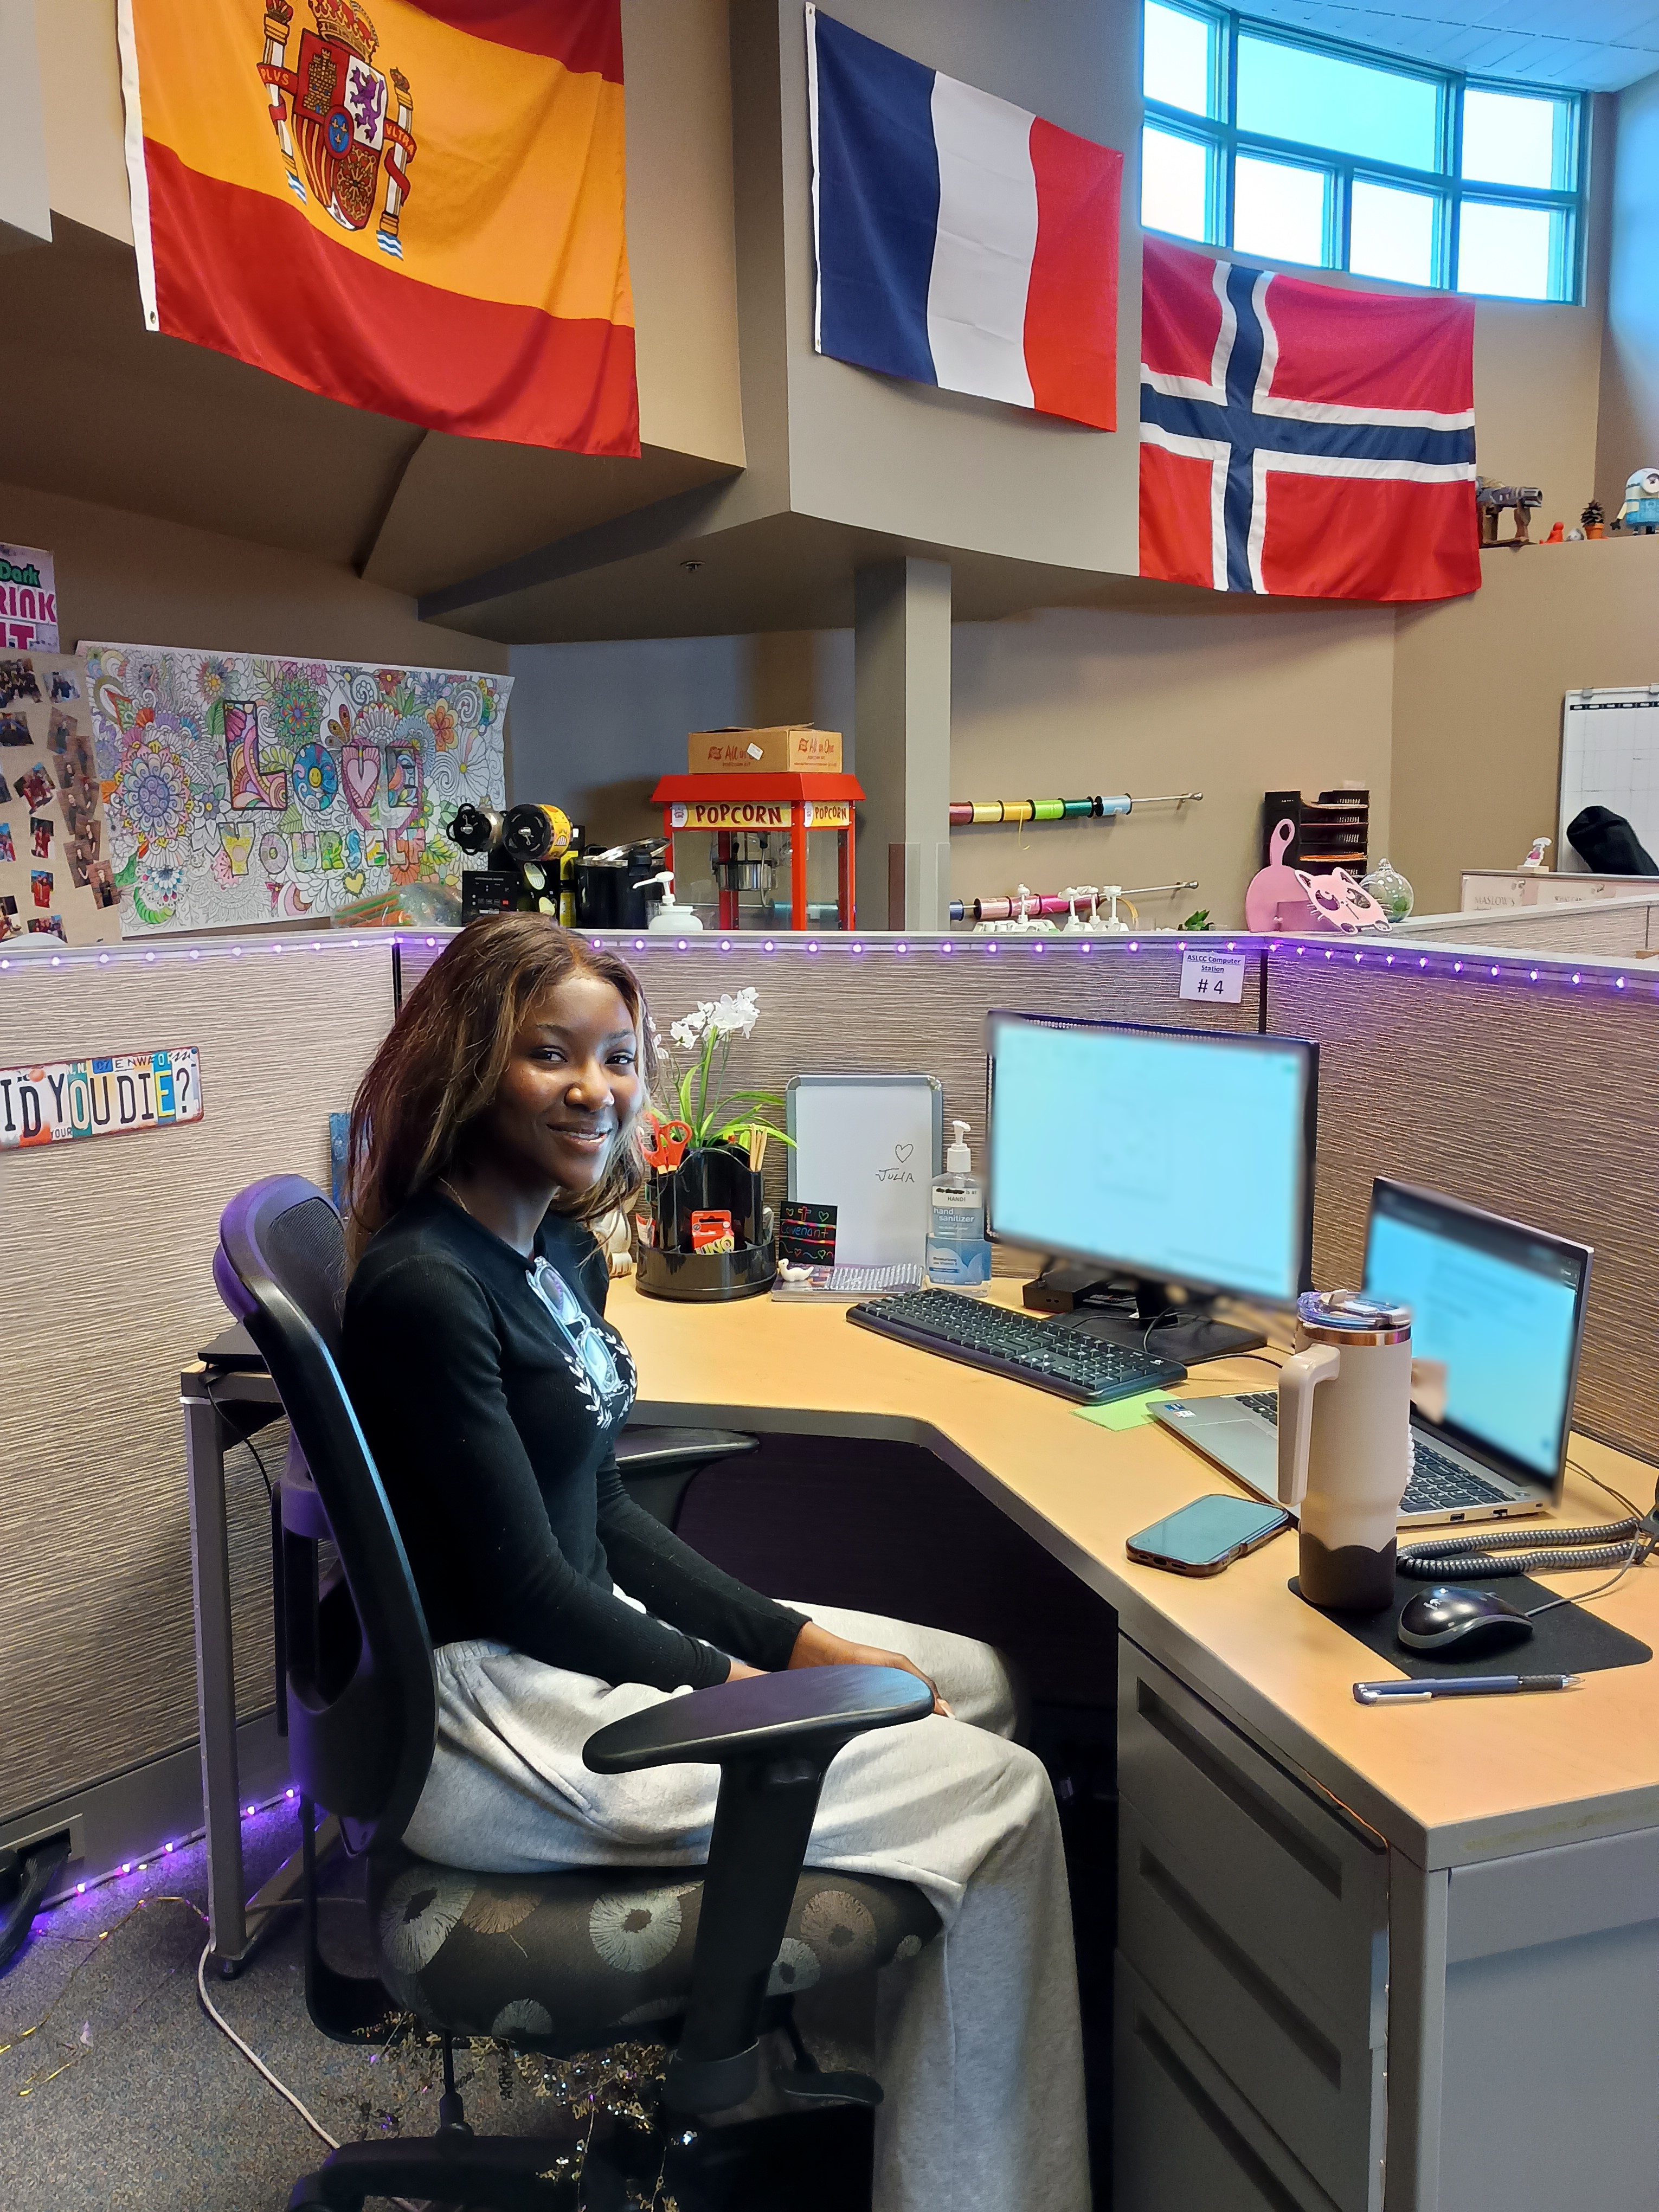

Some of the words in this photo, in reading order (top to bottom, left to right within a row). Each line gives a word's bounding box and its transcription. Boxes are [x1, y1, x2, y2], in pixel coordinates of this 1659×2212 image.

[260, 68, 289, 86] PLVS
[385, 124, 414, 153] VLTRA
[223, 700, 421, 811] LOVE
[725, 745, 738, 761] All
[696, 803, 783, 825] POPCORN
[815, 806, 847, 821] POPCORN
[217, 822, 426, 876] YOURSELF
[1208, 956, 1242, 964] Computer
[1213, 980, 1224, 995] 4
[875, 1167, 915, 1183] JULIA
[934, 1207, 954, 1215] hand
